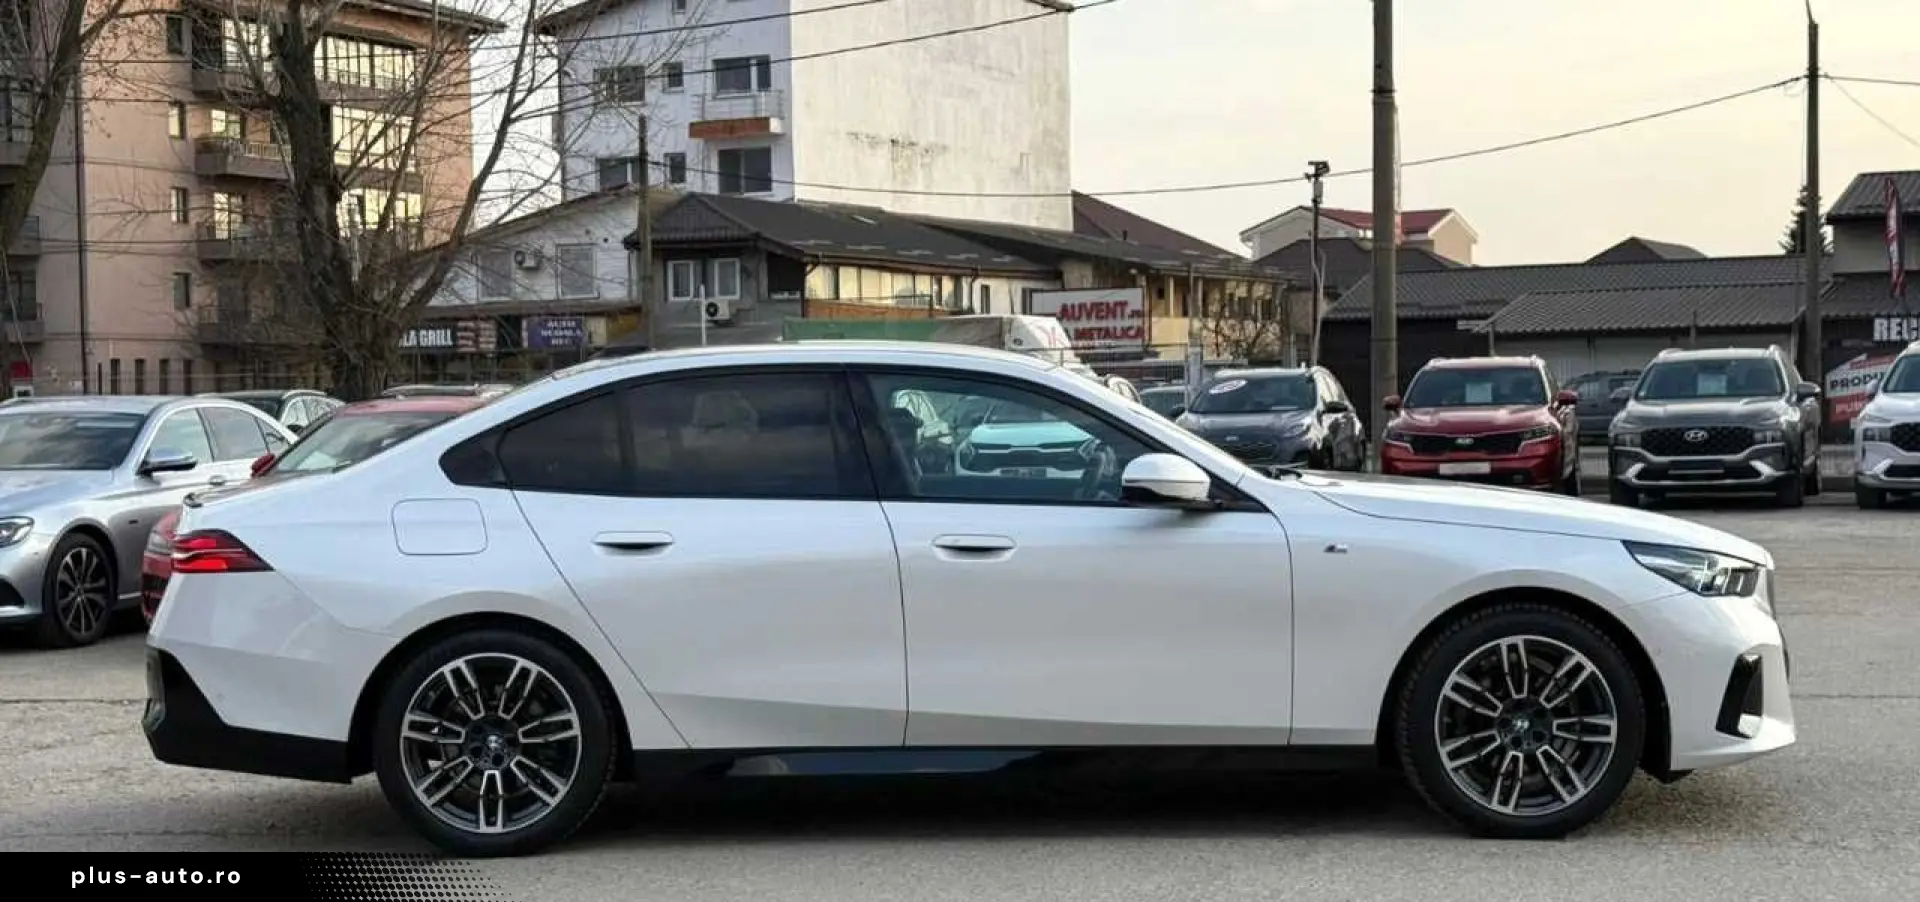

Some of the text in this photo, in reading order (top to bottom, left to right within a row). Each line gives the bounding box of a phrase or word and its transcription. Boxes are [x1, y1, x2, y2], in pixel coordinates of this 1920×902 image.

[419, 328, 453, 347] GRILL
[1873, 317, 1920, 341] REC
[1830, 371, 1886, 390] PRODU
